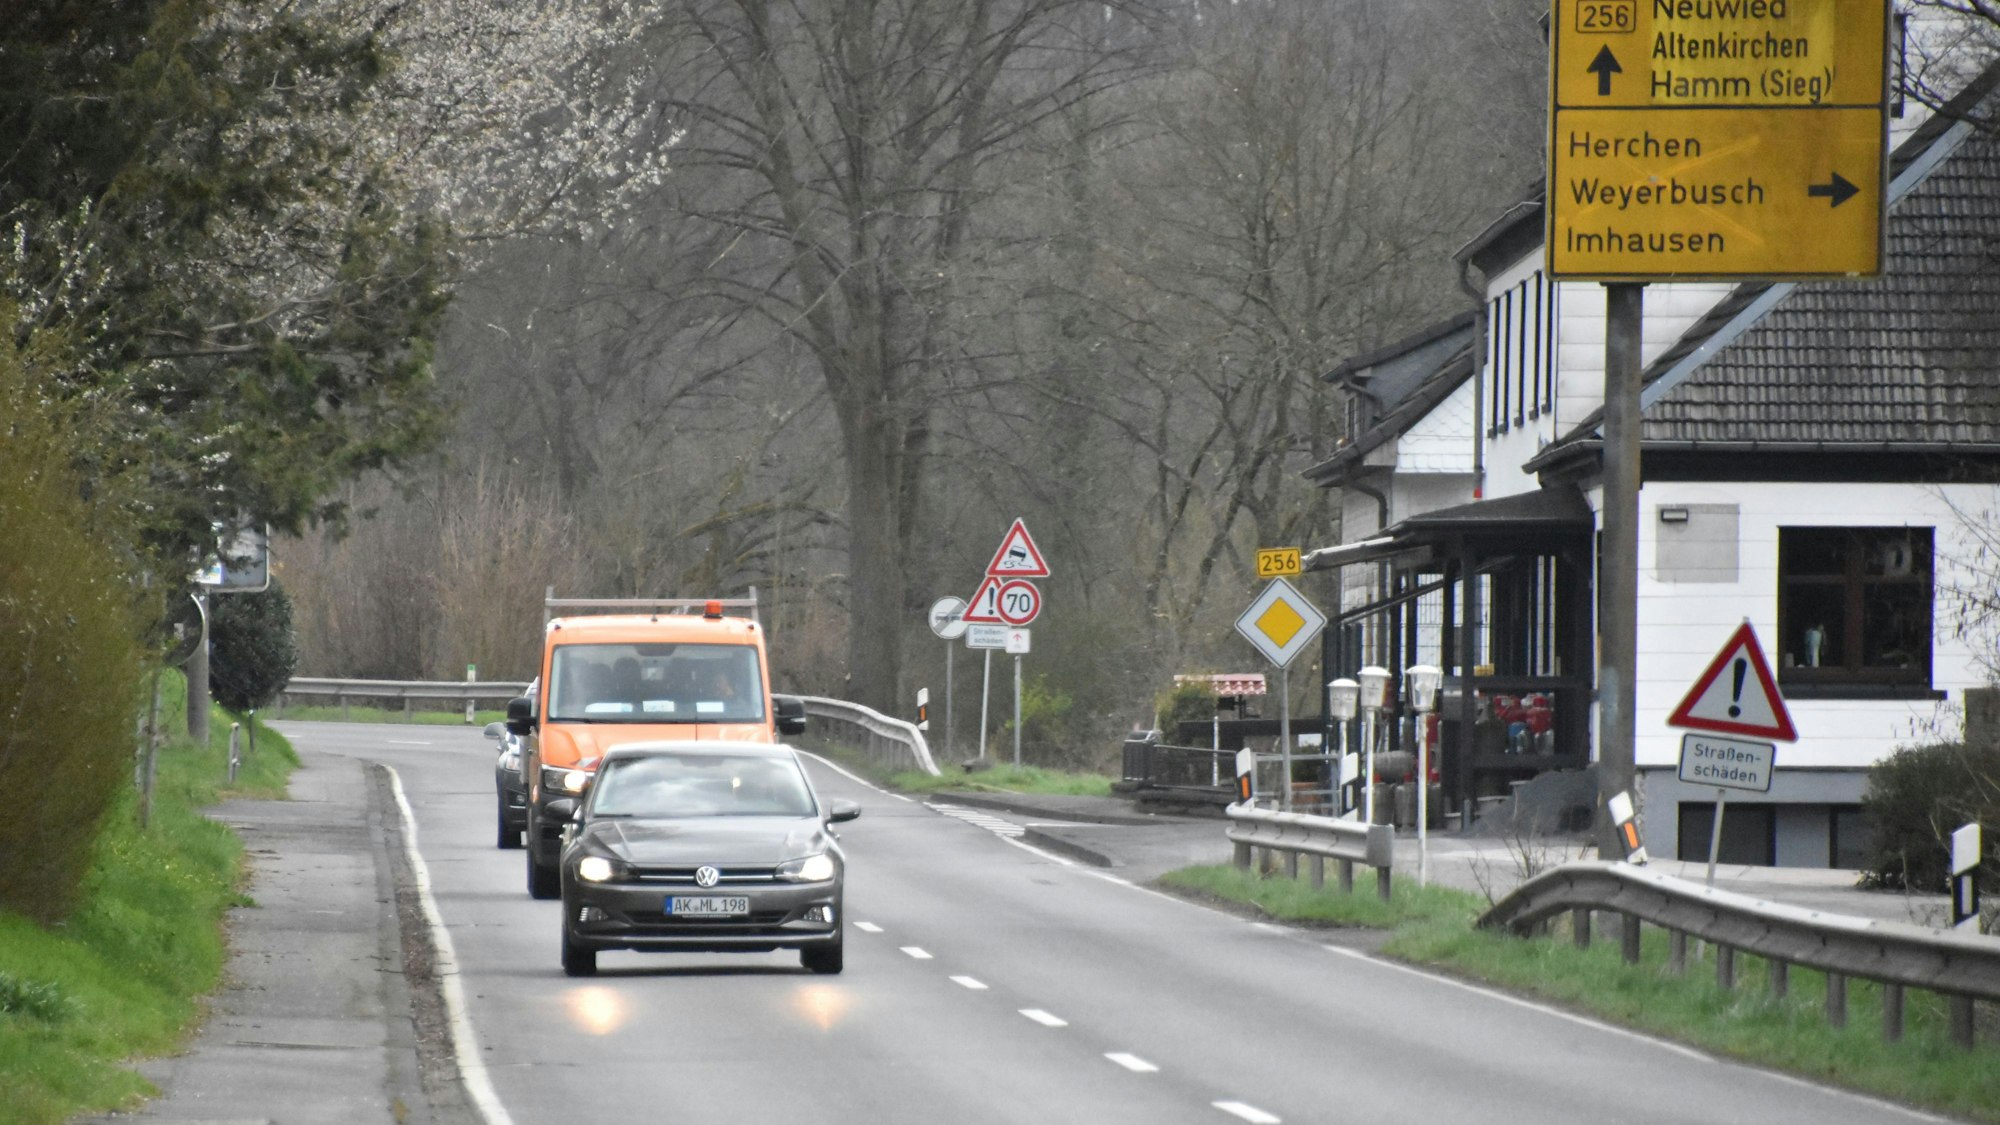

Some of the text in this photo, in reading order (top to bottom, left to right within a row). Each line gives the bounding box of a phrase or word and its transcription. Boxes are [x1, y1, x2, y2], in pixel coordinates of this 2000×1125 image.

[1583, 6, 1629, 28] 256
[1652, 0, 1786, 19] Neuwied
[1652, 31, 1808, 59] Altenkirchen
[1650, 65, 1832, 104] Hamm (Sieg)
[1569, 131, 1701, 157] Herchen
[1571, 178, 1763, 210] Weyerbusch
[1567, 227, 1724, 253] Imhausen
[1262, 553, 1296, 572] 256
[1006, 593, 1031, 613] 70
[1694, 743, 1762, 764] Straßen-
[1694, 764, 1758, 783] schäden
[674, 899, 746, 912] AK ML 198
